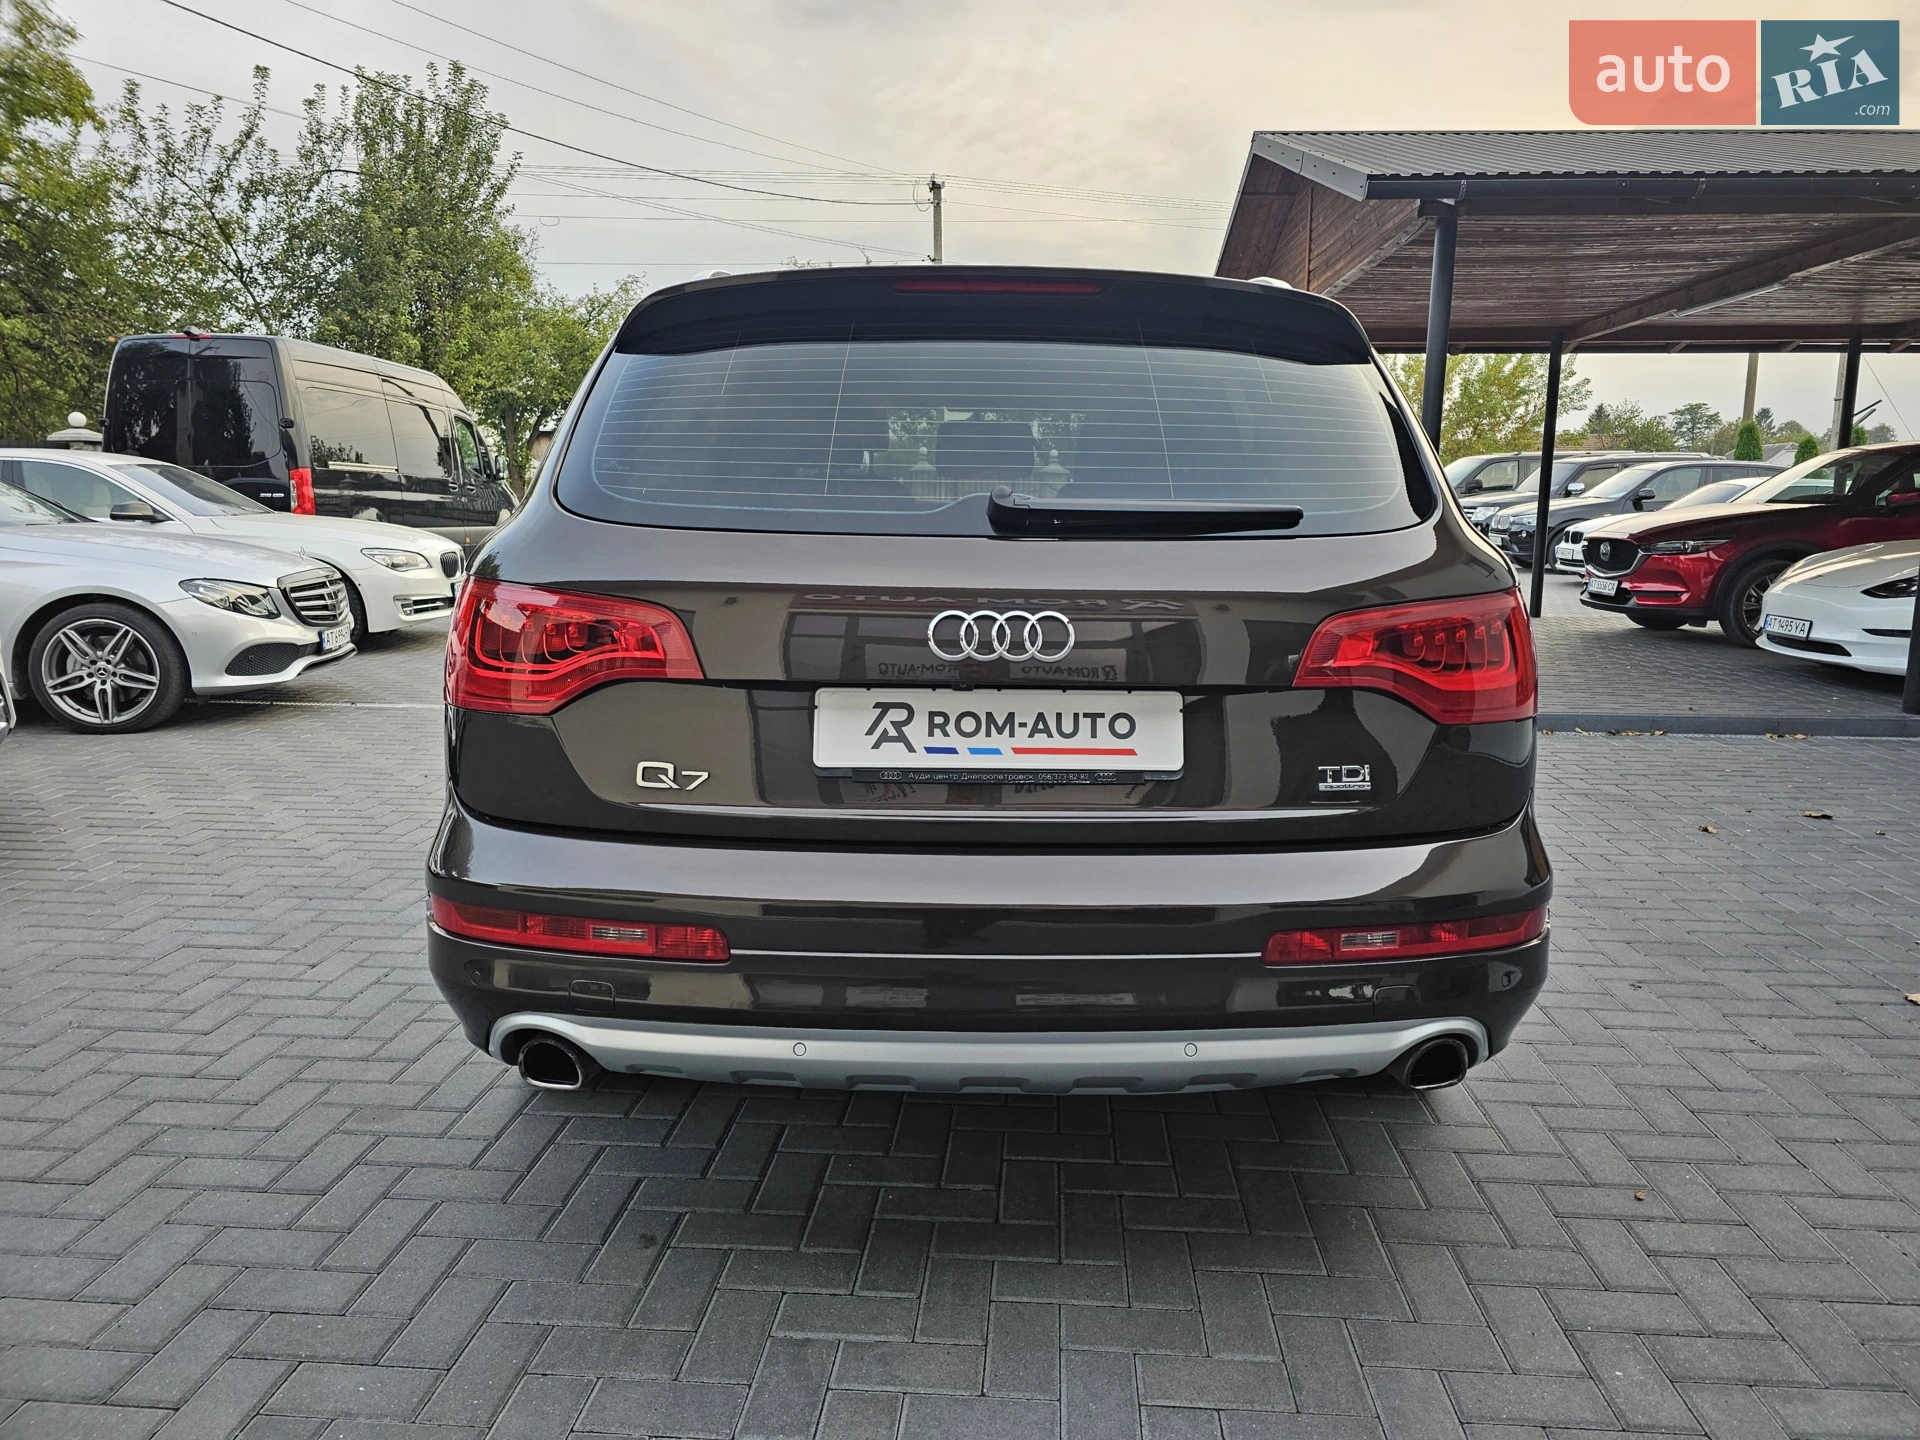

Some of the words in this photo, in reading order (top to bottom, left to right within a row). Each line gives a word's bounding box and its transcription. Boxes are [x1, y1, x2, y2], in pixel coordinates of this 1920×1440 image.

[1768, 617, 1777, 630] AT
[1778, 619, 1794, 632] 1495
[1795, 622, 1806, 635] YA
[928, 711, 1137, 740] ROM-AUTO
[636, 761, 709, 791] Q7
[961, 772, 1034, 781] Днепропетровск
